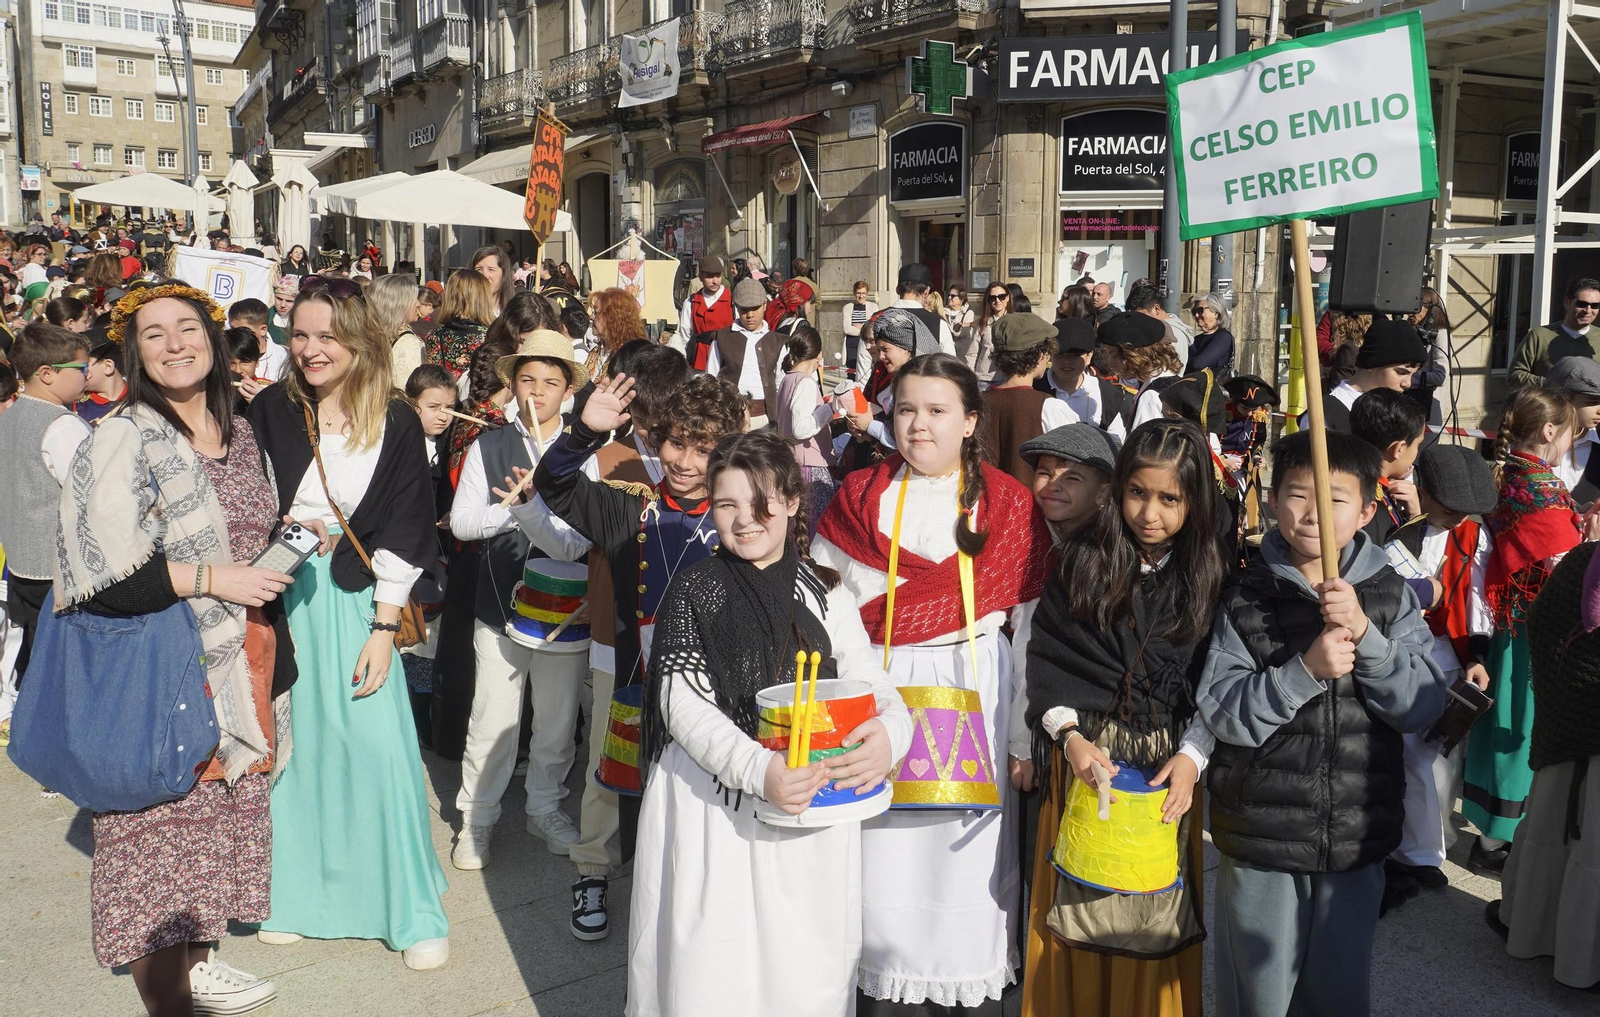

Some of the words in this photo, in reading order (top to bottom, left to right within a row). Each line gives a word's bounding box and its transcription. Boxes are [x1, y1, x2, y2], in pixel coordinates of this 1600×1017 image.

[1010, 45, 1217, 89] FARMAI
[1259, 59, 1315, 94] CEP
[42, 83, 51, 128] HOTEL
[542, 124, 562, 147] CPR
[1190, 119, 1278, 161] CELSO
[1289, 93, 1409, 140] EMILIO
[894, 146, 958, 169] FARMACIA
[1511, 151, 1540, 168] FARM
[898, 177, 920, 186] Puerta
[922, 173, 932, 184] del
[934, 172, 947, 184] Sol,
[949, 174, 953, 184] 4
[1074, 164, 1112, 175] Puerta
[1115, 163, 1132, 174] del
[1135, 163, 1156, 176] Sol,
[1159, 166, 1165, 176] 4
[1224, 152, 1378, 205] FERREIRO
[1513, 176, 1533, 186] Puerta
[214, 273, 234, 299] B
[1242, 386, 1260, 400] N
[1243, 430, 1253, 441] N
[686, 528, 717, 545] N
